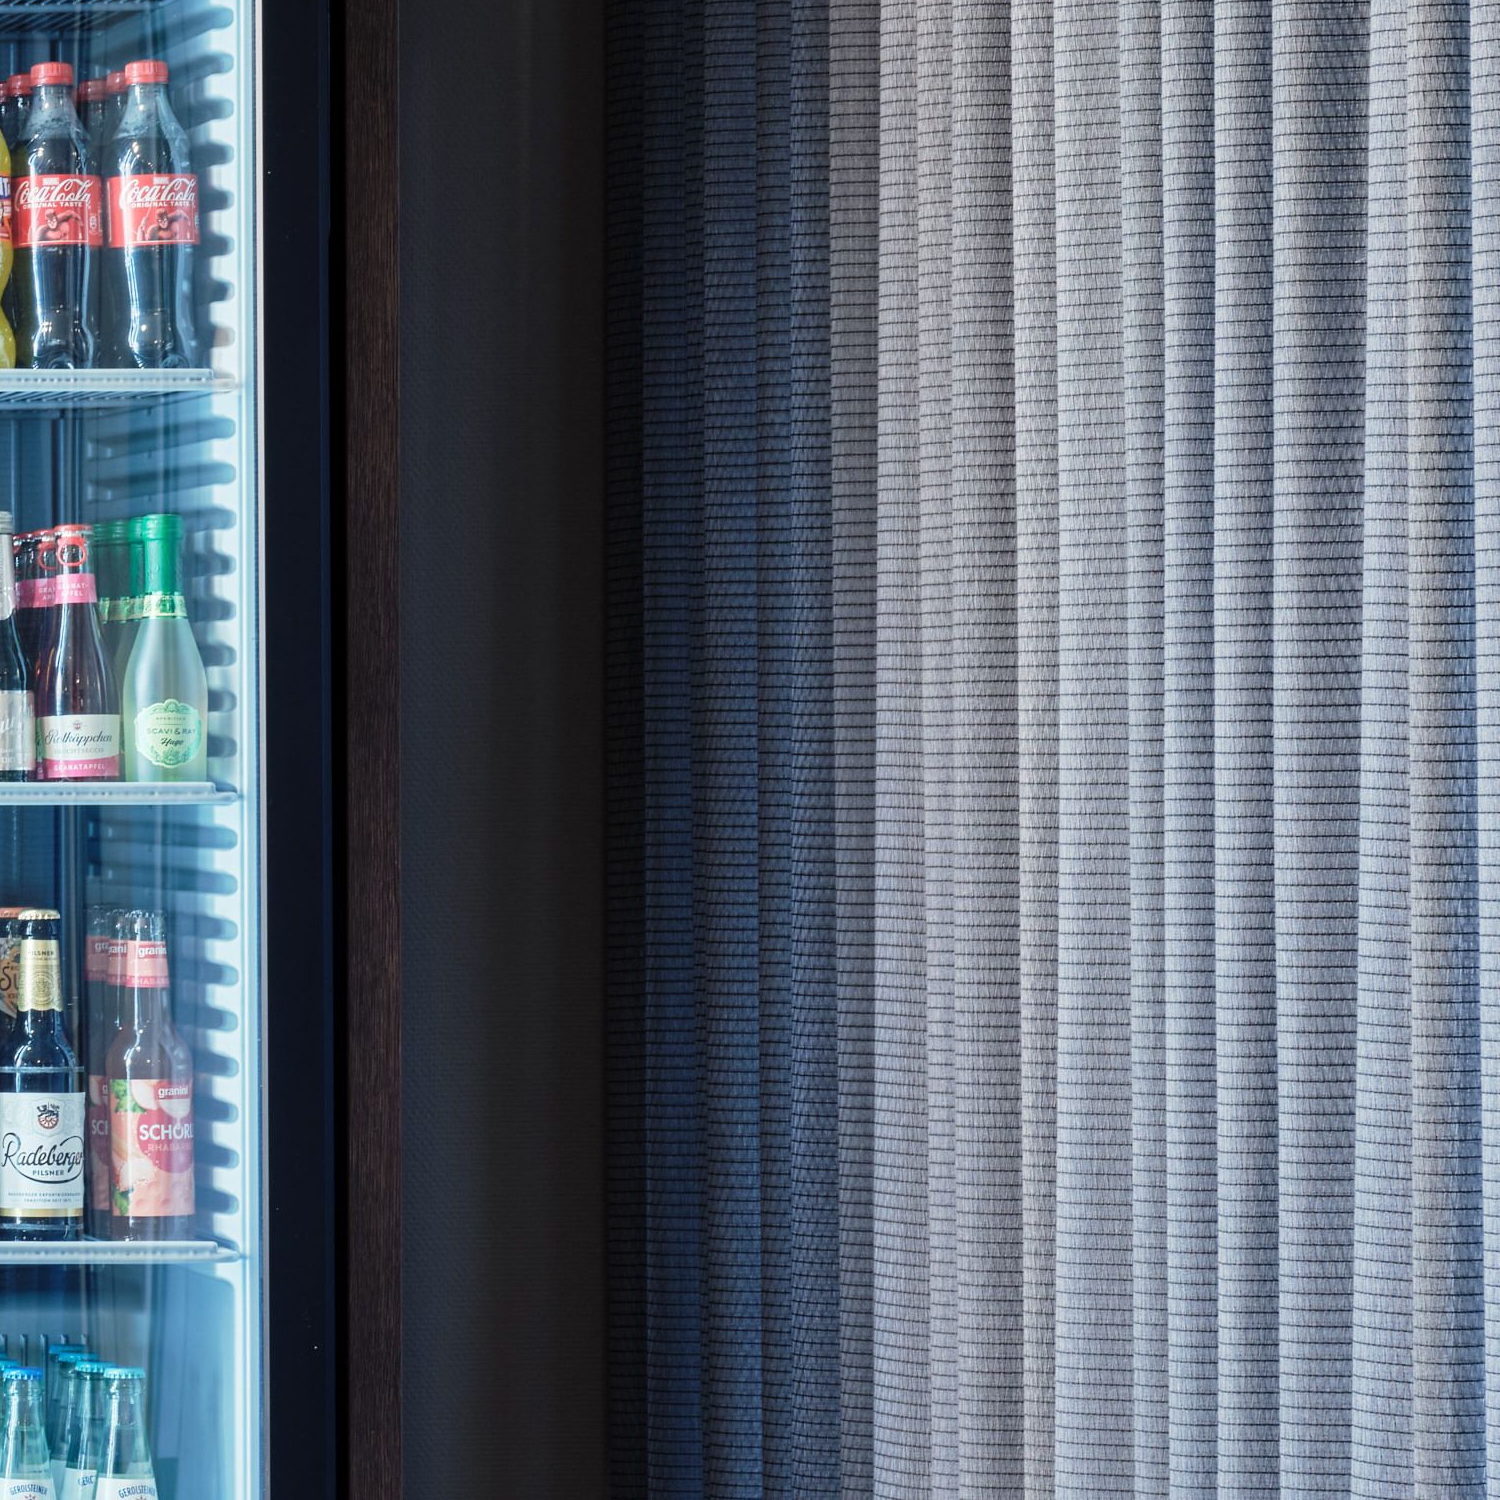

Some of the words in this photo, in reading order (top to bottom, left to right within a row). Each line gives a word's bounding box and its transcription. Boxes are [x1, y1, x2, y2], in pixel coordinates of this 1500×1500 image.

[158, 1085, 189, 1098] granini
[1, 1131, 85, 1174] Radeberger
[32, 1169, 64, 1177] PILSNER
